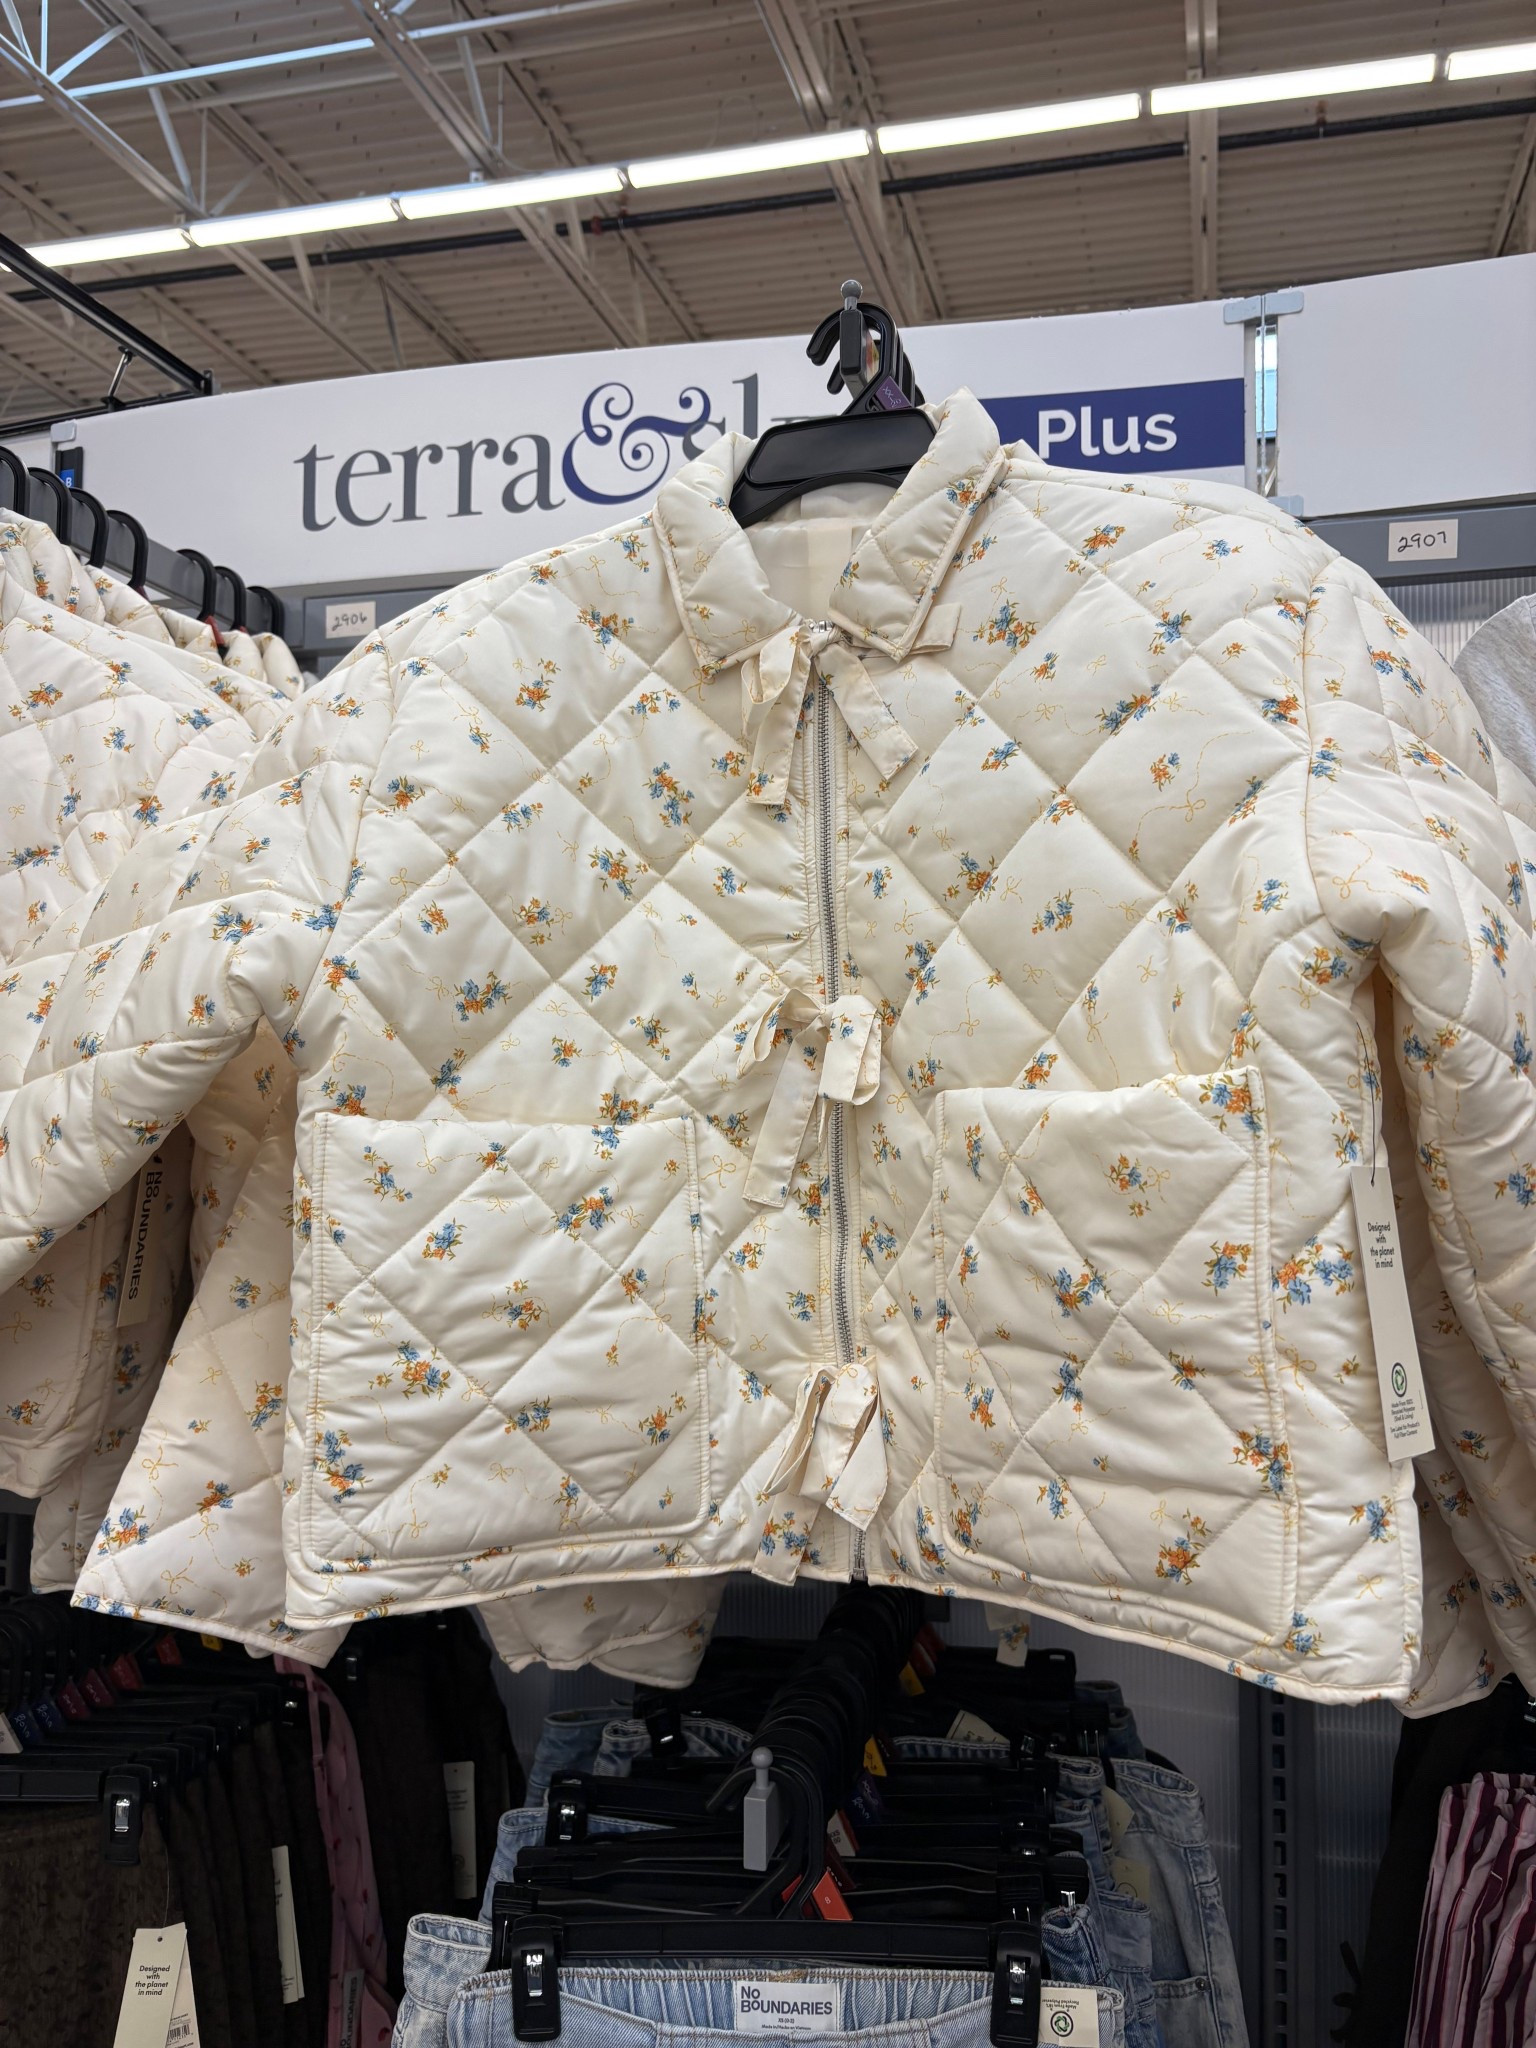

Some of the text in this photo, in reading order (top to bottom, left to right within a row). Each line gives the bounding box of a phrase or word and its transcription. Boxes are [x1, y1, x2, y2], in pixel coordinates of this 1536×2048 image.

[1038, 406, 1178, 459] Plus
[1397, 530, 1447, 553] 2907
[331, 611, 368, 632] 2906
[1367, 1221, 1391, 1235] Designed
[1376, 1234, 1387, 1243] with
[1370, 1246, 1395, 1258] the planet
[1375, 1258, 1393, 1268] in mind
[139, 1964, 171, 1974] Designed
[146, 1981, 169, 1989] planet
